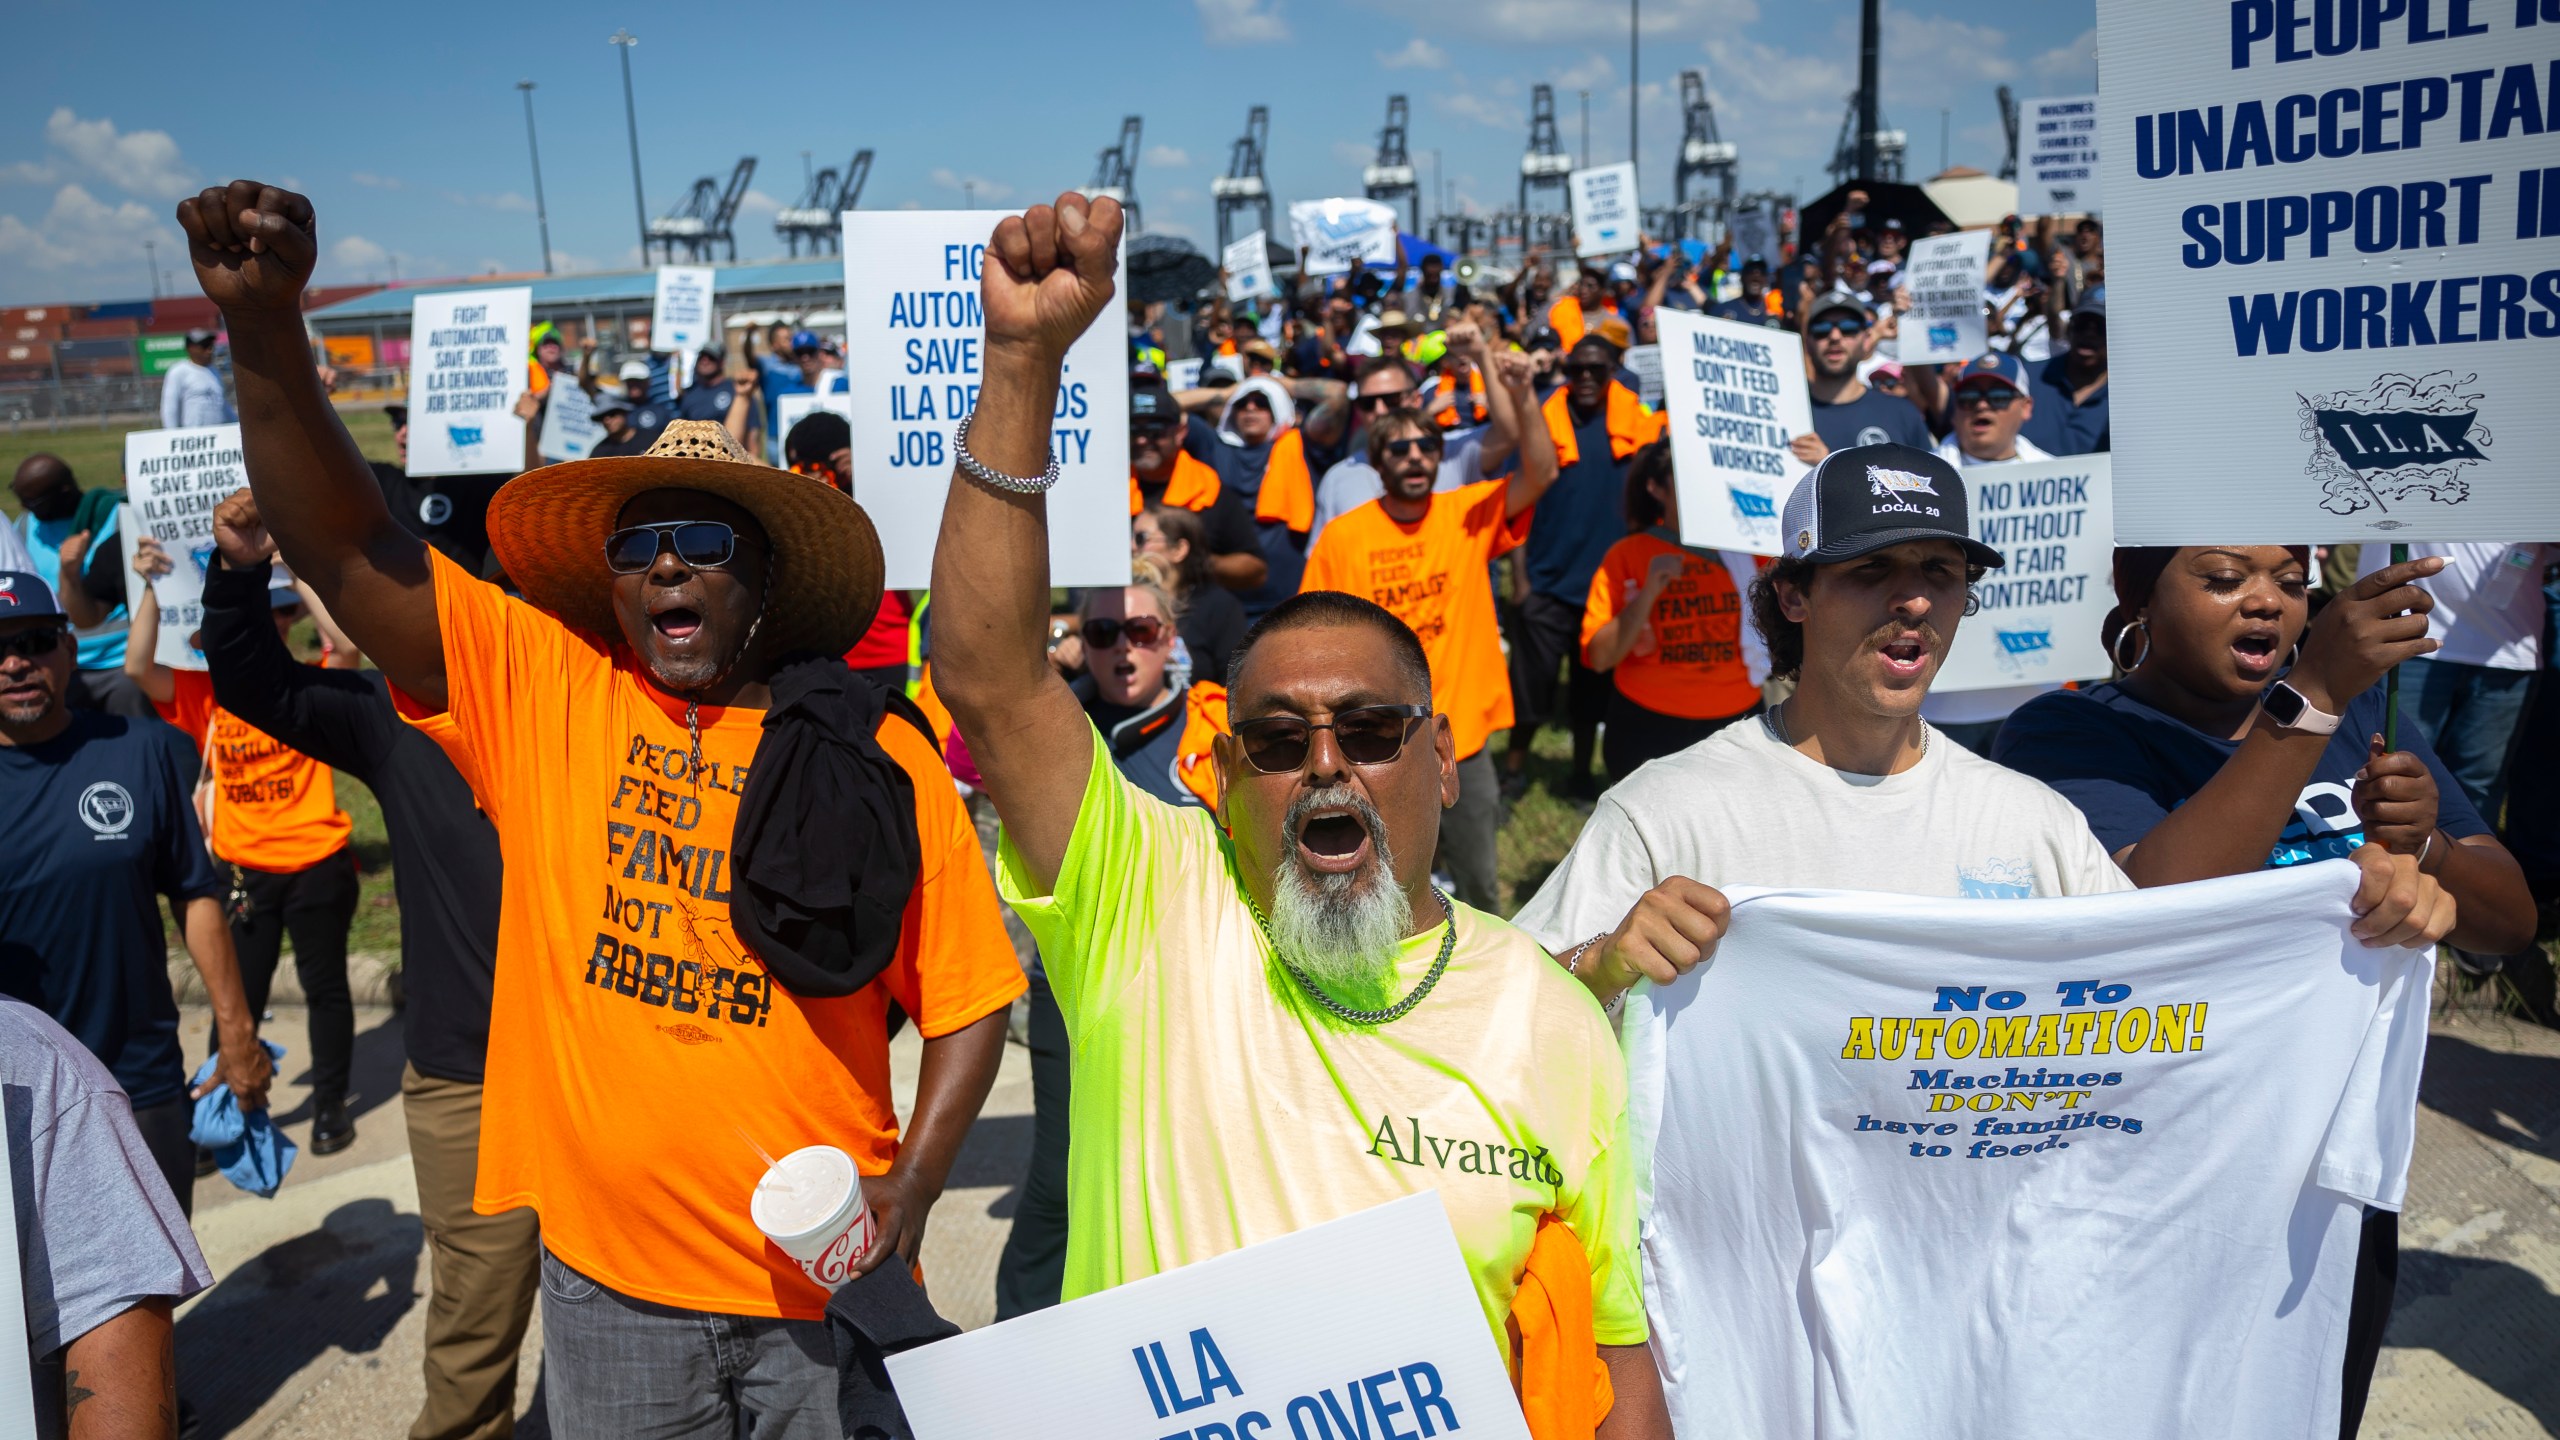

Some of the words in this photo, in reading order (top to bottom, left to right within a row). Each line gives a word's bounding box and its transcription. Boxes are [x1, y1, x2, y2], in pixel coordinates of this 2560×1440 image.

[2182, 174, 2493, 268] SUPPORT
[2228, 270, 2560, 357] WORKERS
[435, 350, 464, 369] SAVE
[906, 338, 979, 375] SAVE
[1693, 331, 1773, 367] MACHINES
[427, 373, 445, 390] ILA
[447, 368, 508, 389] DEMANDS
[1693, 359, 1738, 388] DON'T
[1742, 367, 1779, 395] FEED
[425, 394, 447, 414] JOB
[449, 390, 508, 412] SECURITY
[891, 386, 937, 421] ILA
[171, 433, 217, 454] FIGHT
[890, 431, 945, 467] JOB
[1696, 414, 1762, 447] SUPPORT
[1767, 427, 1791, 450] ILA
[1709, 443, 1785, 476] WORKERS
[151, 473, 192, 496] SAVE
[1980, 483, 2011, 512] NO
[2019, 474, 2090, 507] WORK
[144, 498, 172, 520] ILA
[1872, 503, 1922, 514] LOCAL
[1925, 506, 1941, 517] 20
[1980, 509, 2086, 543] WITHOUT
[2015, 545, 2066, 575] FAIR
[1976, 574, 2088, 610] ONTRACT
[611, 774, 702, 832] FEED
[603, 883, 673, 939] NOT
[584, 931, 773, 1028] ROBOTS!
[1841, 1002, 2208, 1060] AUTOMATION!
[1907, 1067, 2123, 1090] Machines
[1926, 1091, 2092, 1113] DON'T
[1854, 1114, 1958, 1136] have
[1972, 1111, 2143, 1136] families
[1909, 1141, 1952, 1158] to
[1966, 1134, 2070, 1159] feed.
[1132, 1327, 1245, 1419] ILA
[1286, 1361, 1461, 1440] OVER
